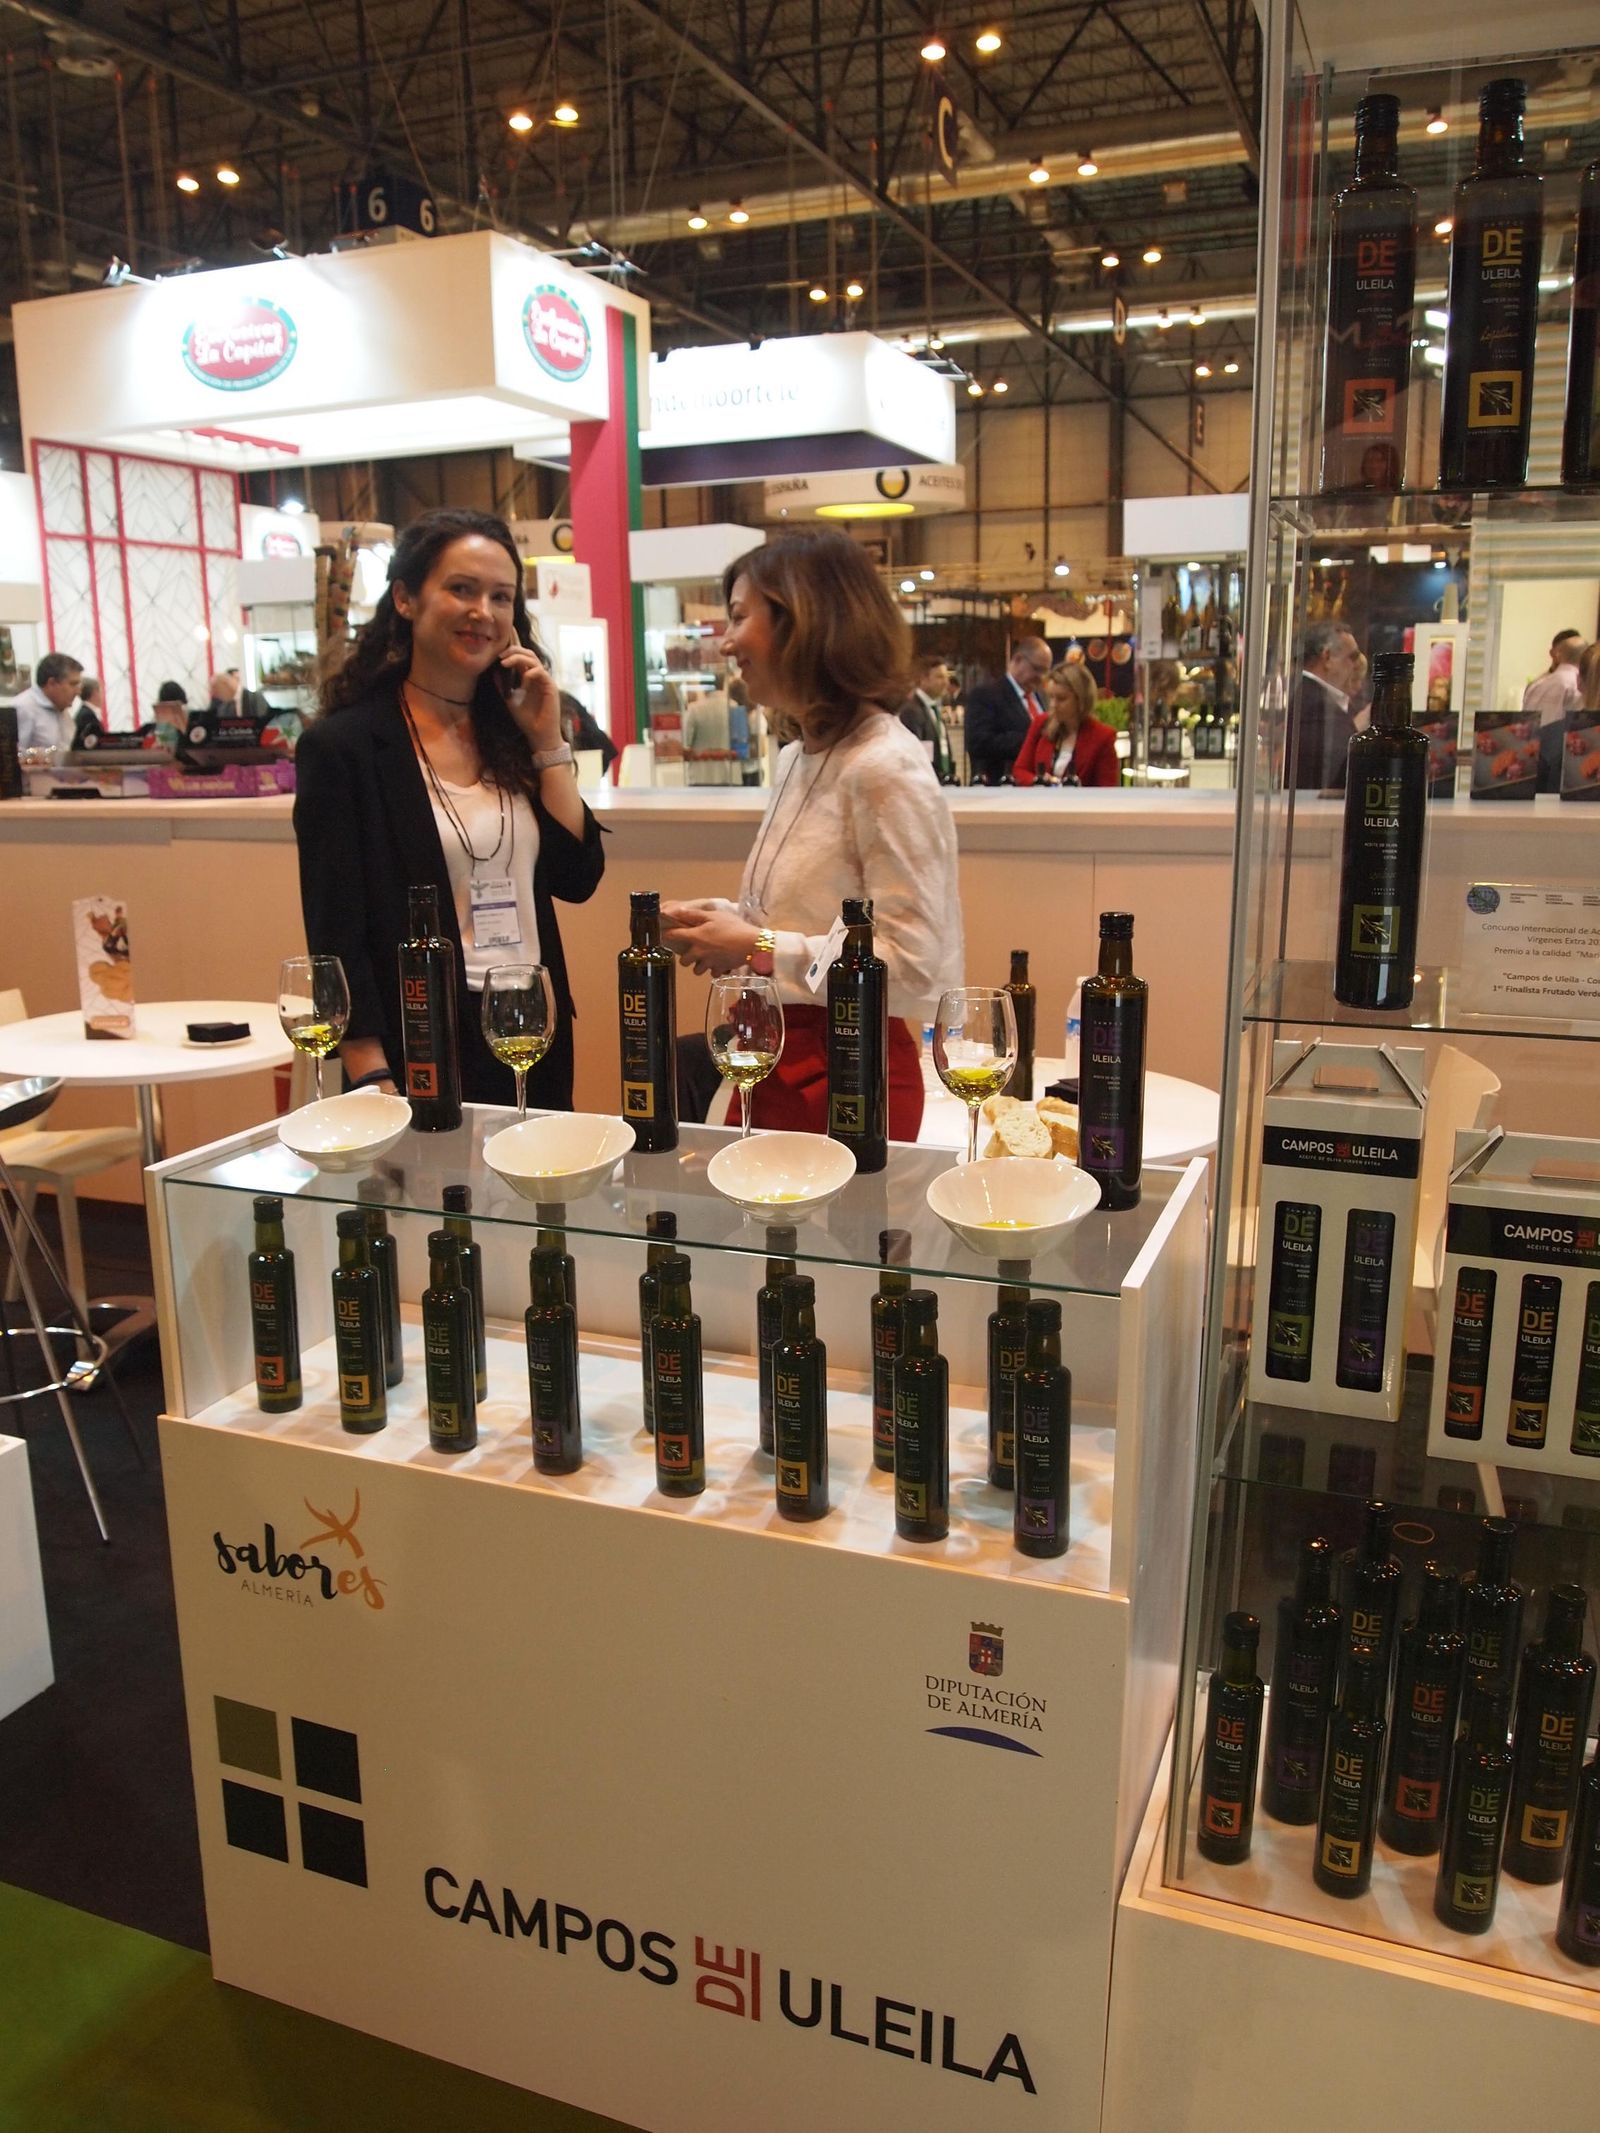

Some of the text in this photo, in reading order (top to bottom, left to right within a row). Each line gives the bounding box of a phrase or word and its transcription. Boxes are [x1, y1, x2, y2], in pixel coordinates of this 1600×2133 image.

[368, 187, 387, 222] 6
[420, 199, 434, 232] 6
[1483, 228, 1524, 259] DE
[1358, 240, 1397, 268] DE
[1481, 268, 1521, 281] ULEILA
[1356, 279, 1395, 291] ULEILA
[1366, 784, 1400, 809] DE
[1364, 817, 1400, 828] ULEILA
[1481, 922, 1520, 932] Concurso
[1521, 924, 1576, 935] Internacional
[1578, 927, 1589, 935] de
[1564, 937, 1586, 946] Extra
[1494, 946, 1524, 956] Premio
[1532, 947, 1541, 957] la
[1542, 948, 1572, 958] calidad
[1542, 975, 1553, 983] de
[1554, 975, 1580, 984] Uleila
[404, 980, 427, 997] DE
[1505, 985, 1541, 995] Finalista
[1542, 987, 1576, 997] Frutado
[623, 993, 647, 1013] DE
[834, 1001, 861, 1022] DE
[834, 1027, 861, 1037] ULEILA
[1092, 1053, 1122, 1065] ULEILA
[1281, 1138, 1334, 1155] CAMPOS
[1352, 1144, 1400, 1162] ULEILA
[1284, 1213, 1316, 1238] DE
[1503, 1223, 1574, 1244] CAMPOS
[1282, 1240, 1313, 1252] ULEILA
[1526, 1243, 1550, 1252] ACEITE
[1551, 1245, 1562, 1253] DE
[1563, 1247, 1584, 1255] OLIVA
[1353, 1255, 1385, 1268] ULEILA
[253, 1282, 275, 1299] DE
[338, 1300, 360, 1317] DE
[1456, 1291, 1487, 1314] DE
[1454, 1317, 1484, 1329] ULEILA
[1522, 1310, 1555, 1331] DE
[427, 1326, 449, 1343] DE
[875, 1327, 898, 1348] DE
[1521, 1334, 1552, 1346] ULEILA
[657, 1353, 681, 1371] DE
[776, 1375, 800, 1395] DE
[896, 1394, 919, 1415] DE
[896, 1418, 920, 1430] ULEILA
[1023, 1433, 1050, 1445] ULEILA
[213, 1522, 388, 1611] sabores
[1352, 1610, 1383, 1632] DE
[1350, 1634, 1380, 1648] ULEILA
[1470, 1631, 1501, 1653] DE
[1468, 1655, 1499, 1669] ULEILA
[924, 1674, 1048, 1714] DIPUTACIÓN
[1289, 1681, 1320, 1695] ULEILA
[1413, 1686, 1447, 1709] DE
[927, 1693, 1044, 1732] DE ALMERÍA
[1411, 1711, 1443, 1724] ULEILA
[1216, 1715, 1246, 1739] DE
[1541, 1712, 1576, 1736] DE
[1215, 1739, 1243, 1752] ULEILA
[1538, 1739, 1572, 1753] ULEILA
[1334, 1753, 1363, 1776] DE
[1333, 1775, 1361, 1790] ULEILA
[1469, 1790, 1500, 1811] DE
[1467, 1813, 1498, 1825] ULEILA
[424, 1866, 1039, 2096] CAMPOS DE ULEILA
